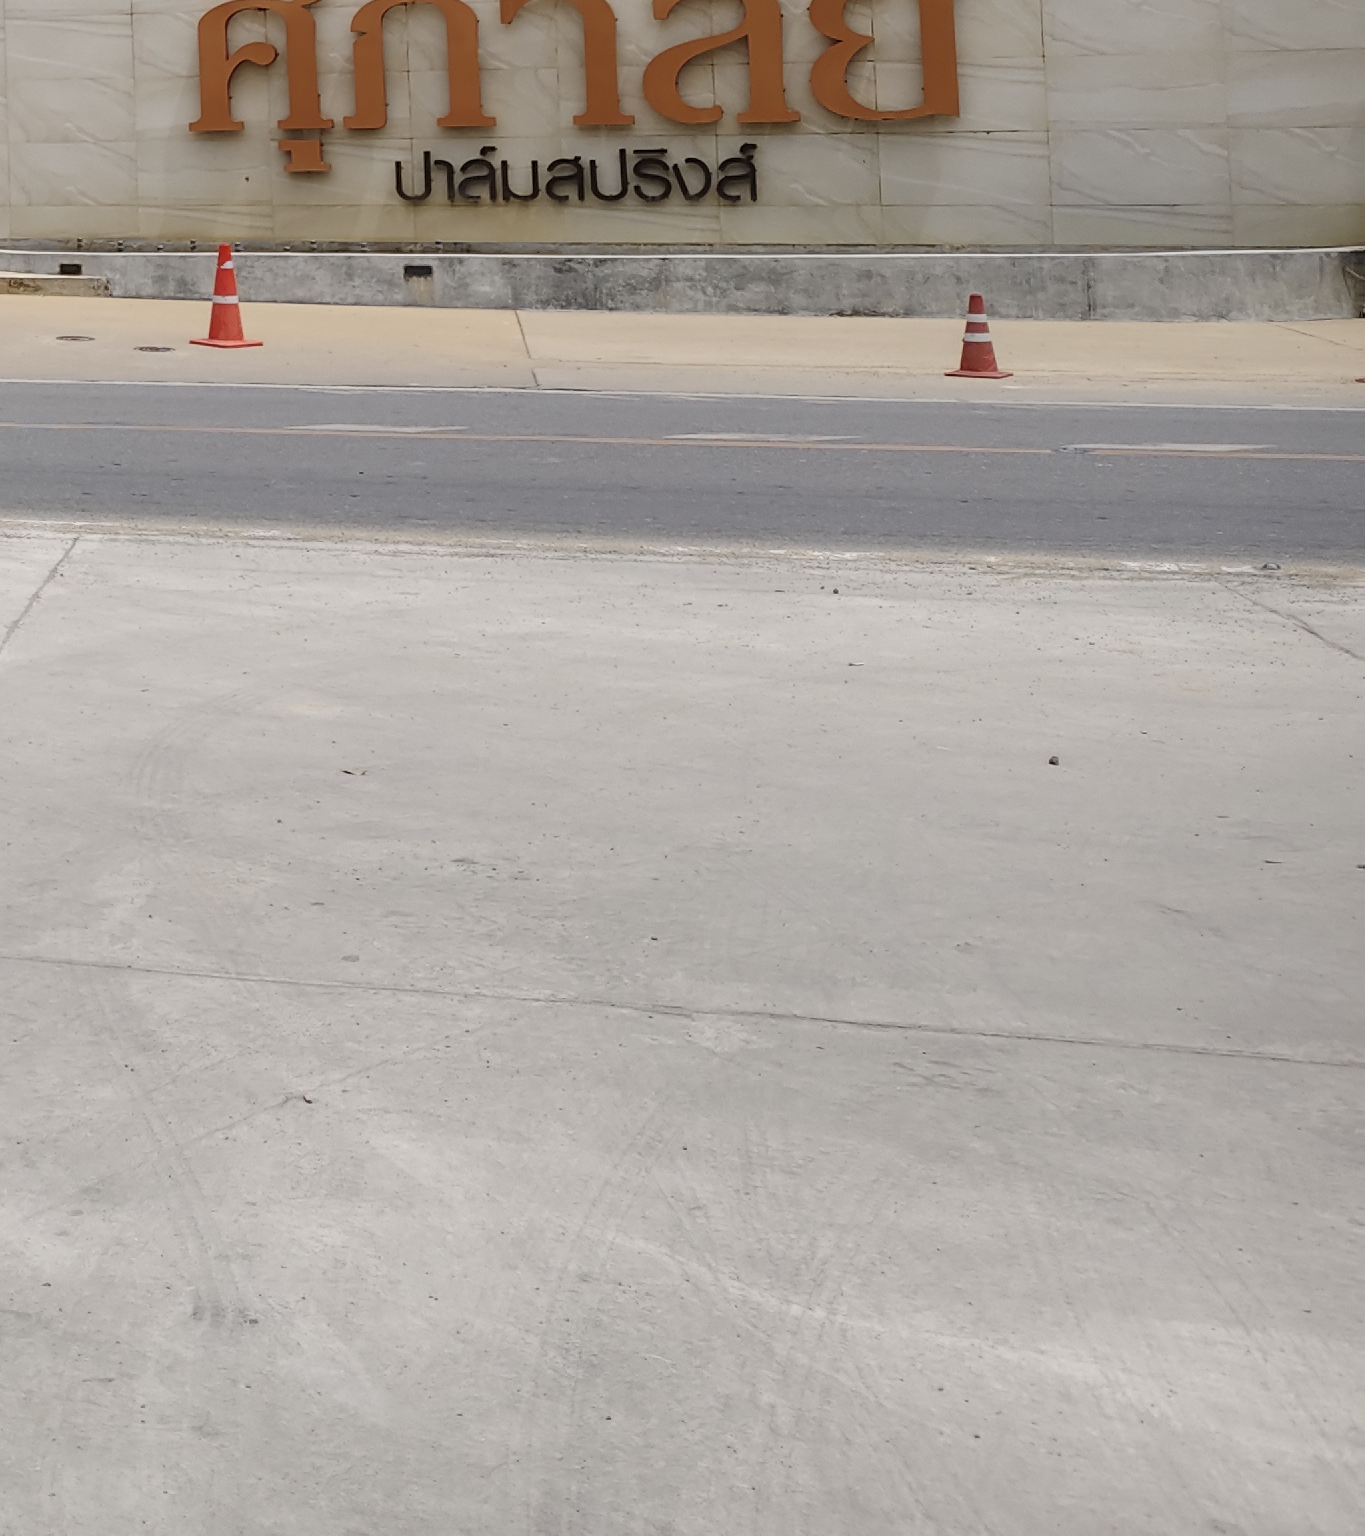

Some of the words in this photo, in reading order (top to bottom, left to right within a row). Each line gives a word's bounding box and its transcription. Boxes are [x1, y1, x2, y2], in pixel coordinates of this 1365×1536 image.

[394, 143, 758, 204] ปาล์มสปริงส์
